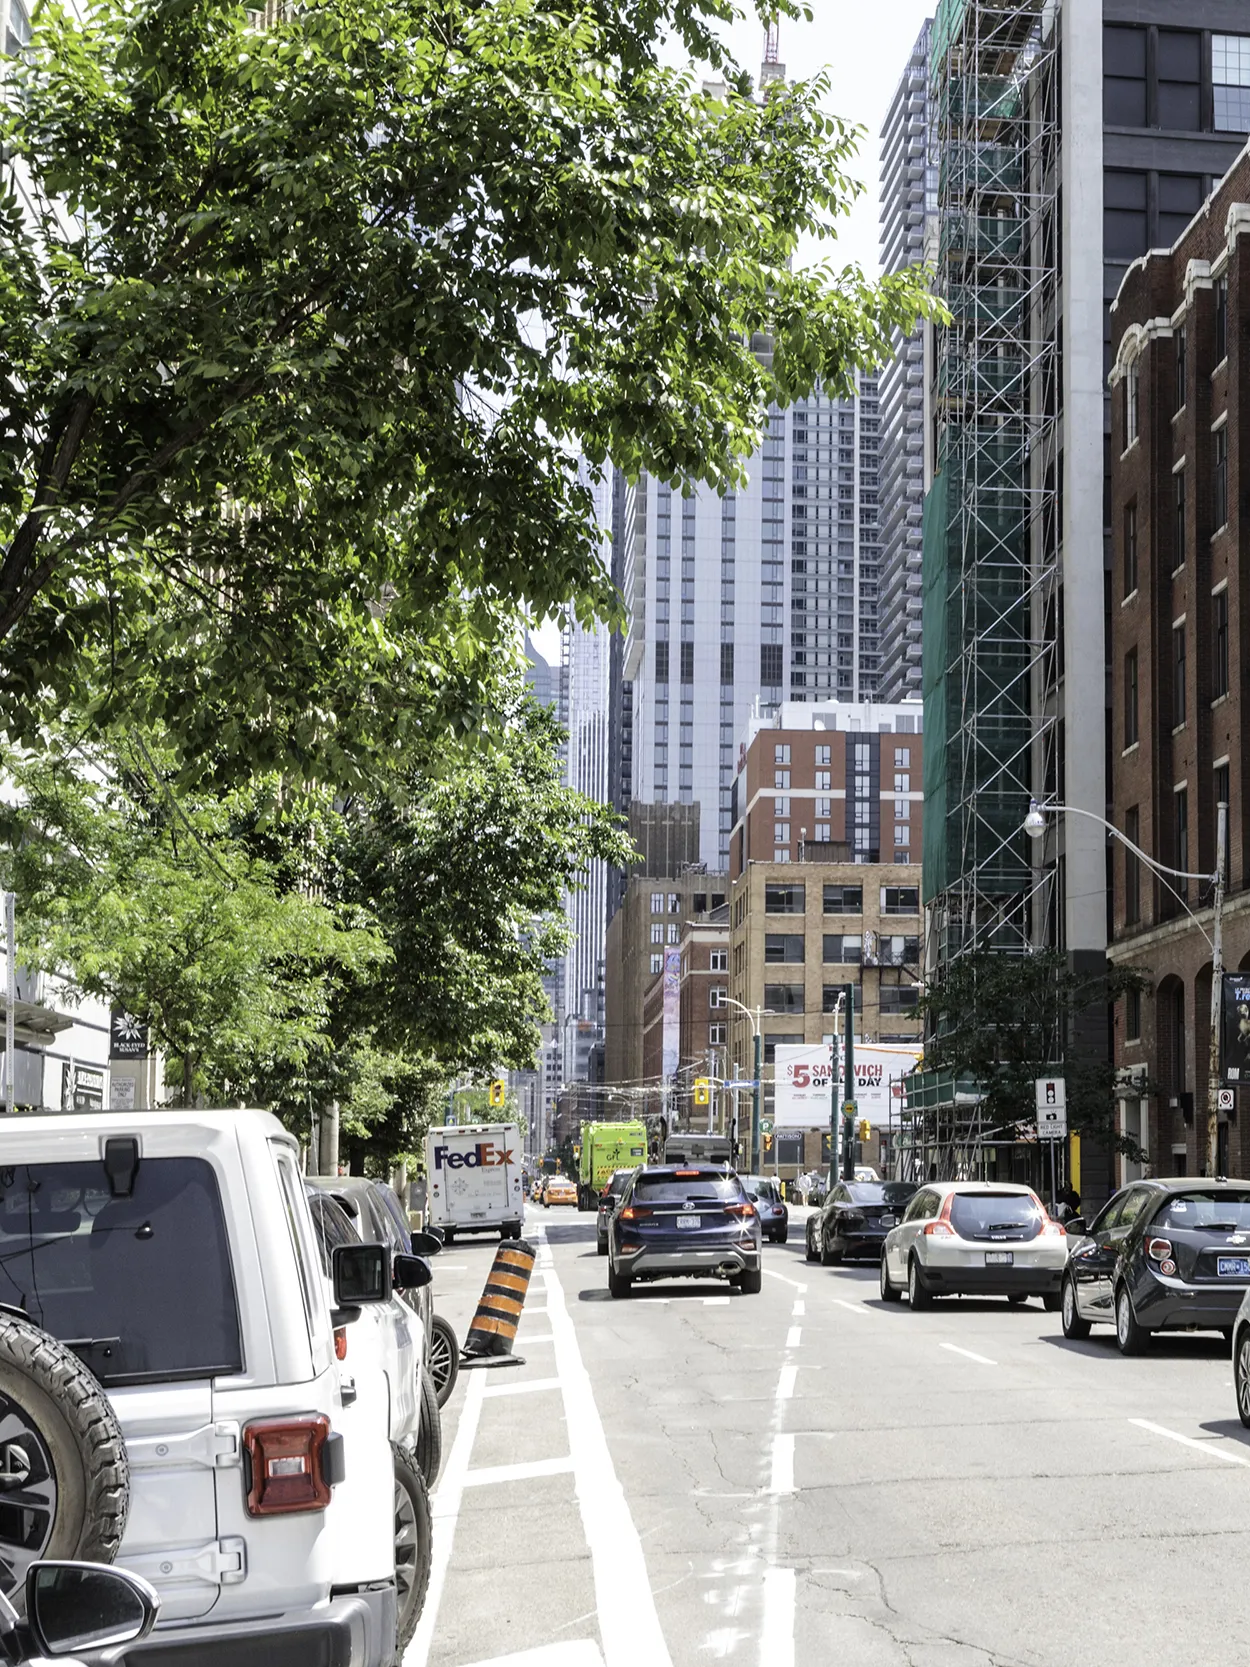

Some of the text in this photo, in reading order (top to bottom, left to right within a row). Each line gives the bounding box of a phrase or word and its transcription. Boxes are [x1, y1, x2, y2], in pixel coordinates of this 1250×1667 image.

[1227, 1067, 1240, 1080] ROM
[813, 1078, 828, 1087] OF
[858, 1077, 882, 1087] DAY
[434, 1142, 515, 1170] FedEx
